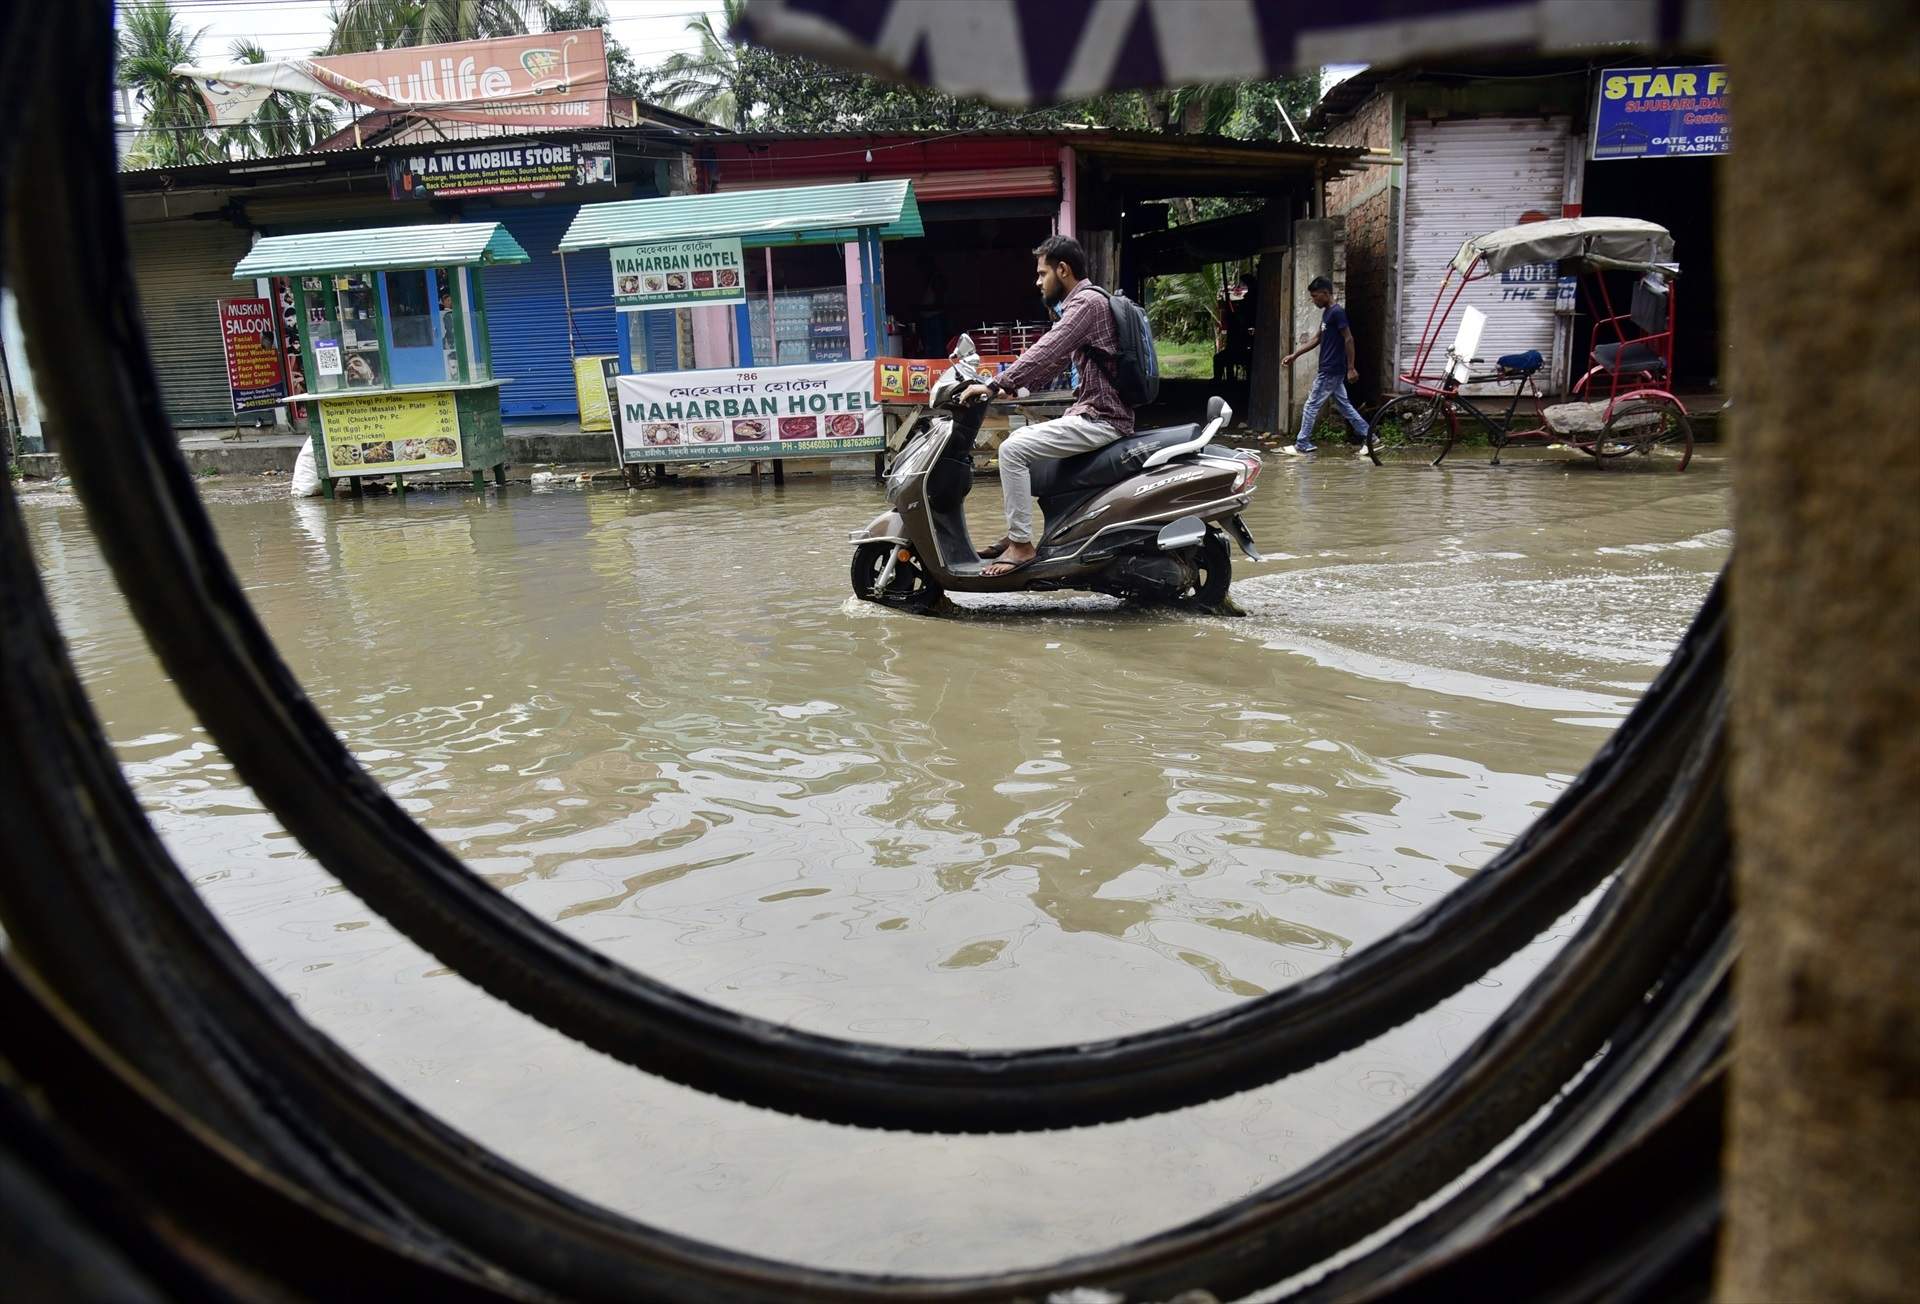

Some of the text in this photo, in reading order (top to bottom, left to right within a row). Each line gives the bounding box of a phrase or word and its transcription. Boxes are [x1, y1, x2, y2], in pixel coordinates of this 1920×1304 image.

[1605, 74, 1697, 99] STAR
[483, 101, 590, 117] GROCERY STORE
[1651, 136, 1691, 145] GATE,
[1670, 144, 1717, 152] TRASH,
[428, 146, 572, 173] A M C MOBILE STORE
[482, 170, 498, 178] Smart
[519, 167, 537, 175] Sound
[426, 182, 440, 190] Back
[463, 179, 484, 187] Second
[499, 176, 519, 184] Mobile
[533, 173, 558, 182] available
[616, 251, 738, 274] MAHARBAN HOTEL
[1503, 287, 1540, 301] THE
[228, 304, 265, 316] MUSKAN
[226, 318, 272, 334] SALOON
[736, 373, 758, 381] 786
[886, 375, 897, 386] Tide
[912, 375, 926, 386] Tide
[765, 378, 828, 394] হোটেল
[326, 408, 344, 416] Spiral
[346, 407, 367, 415] Potato
[626, 391, 879, 422] MAHARBAN HOTEL
[348, 415, 379, 425] (Chicken)
[331, 434, 353, 443] Biryani
[354, 431, 385, 441] (Chicken)
[781, 442, 792, 450] PH
